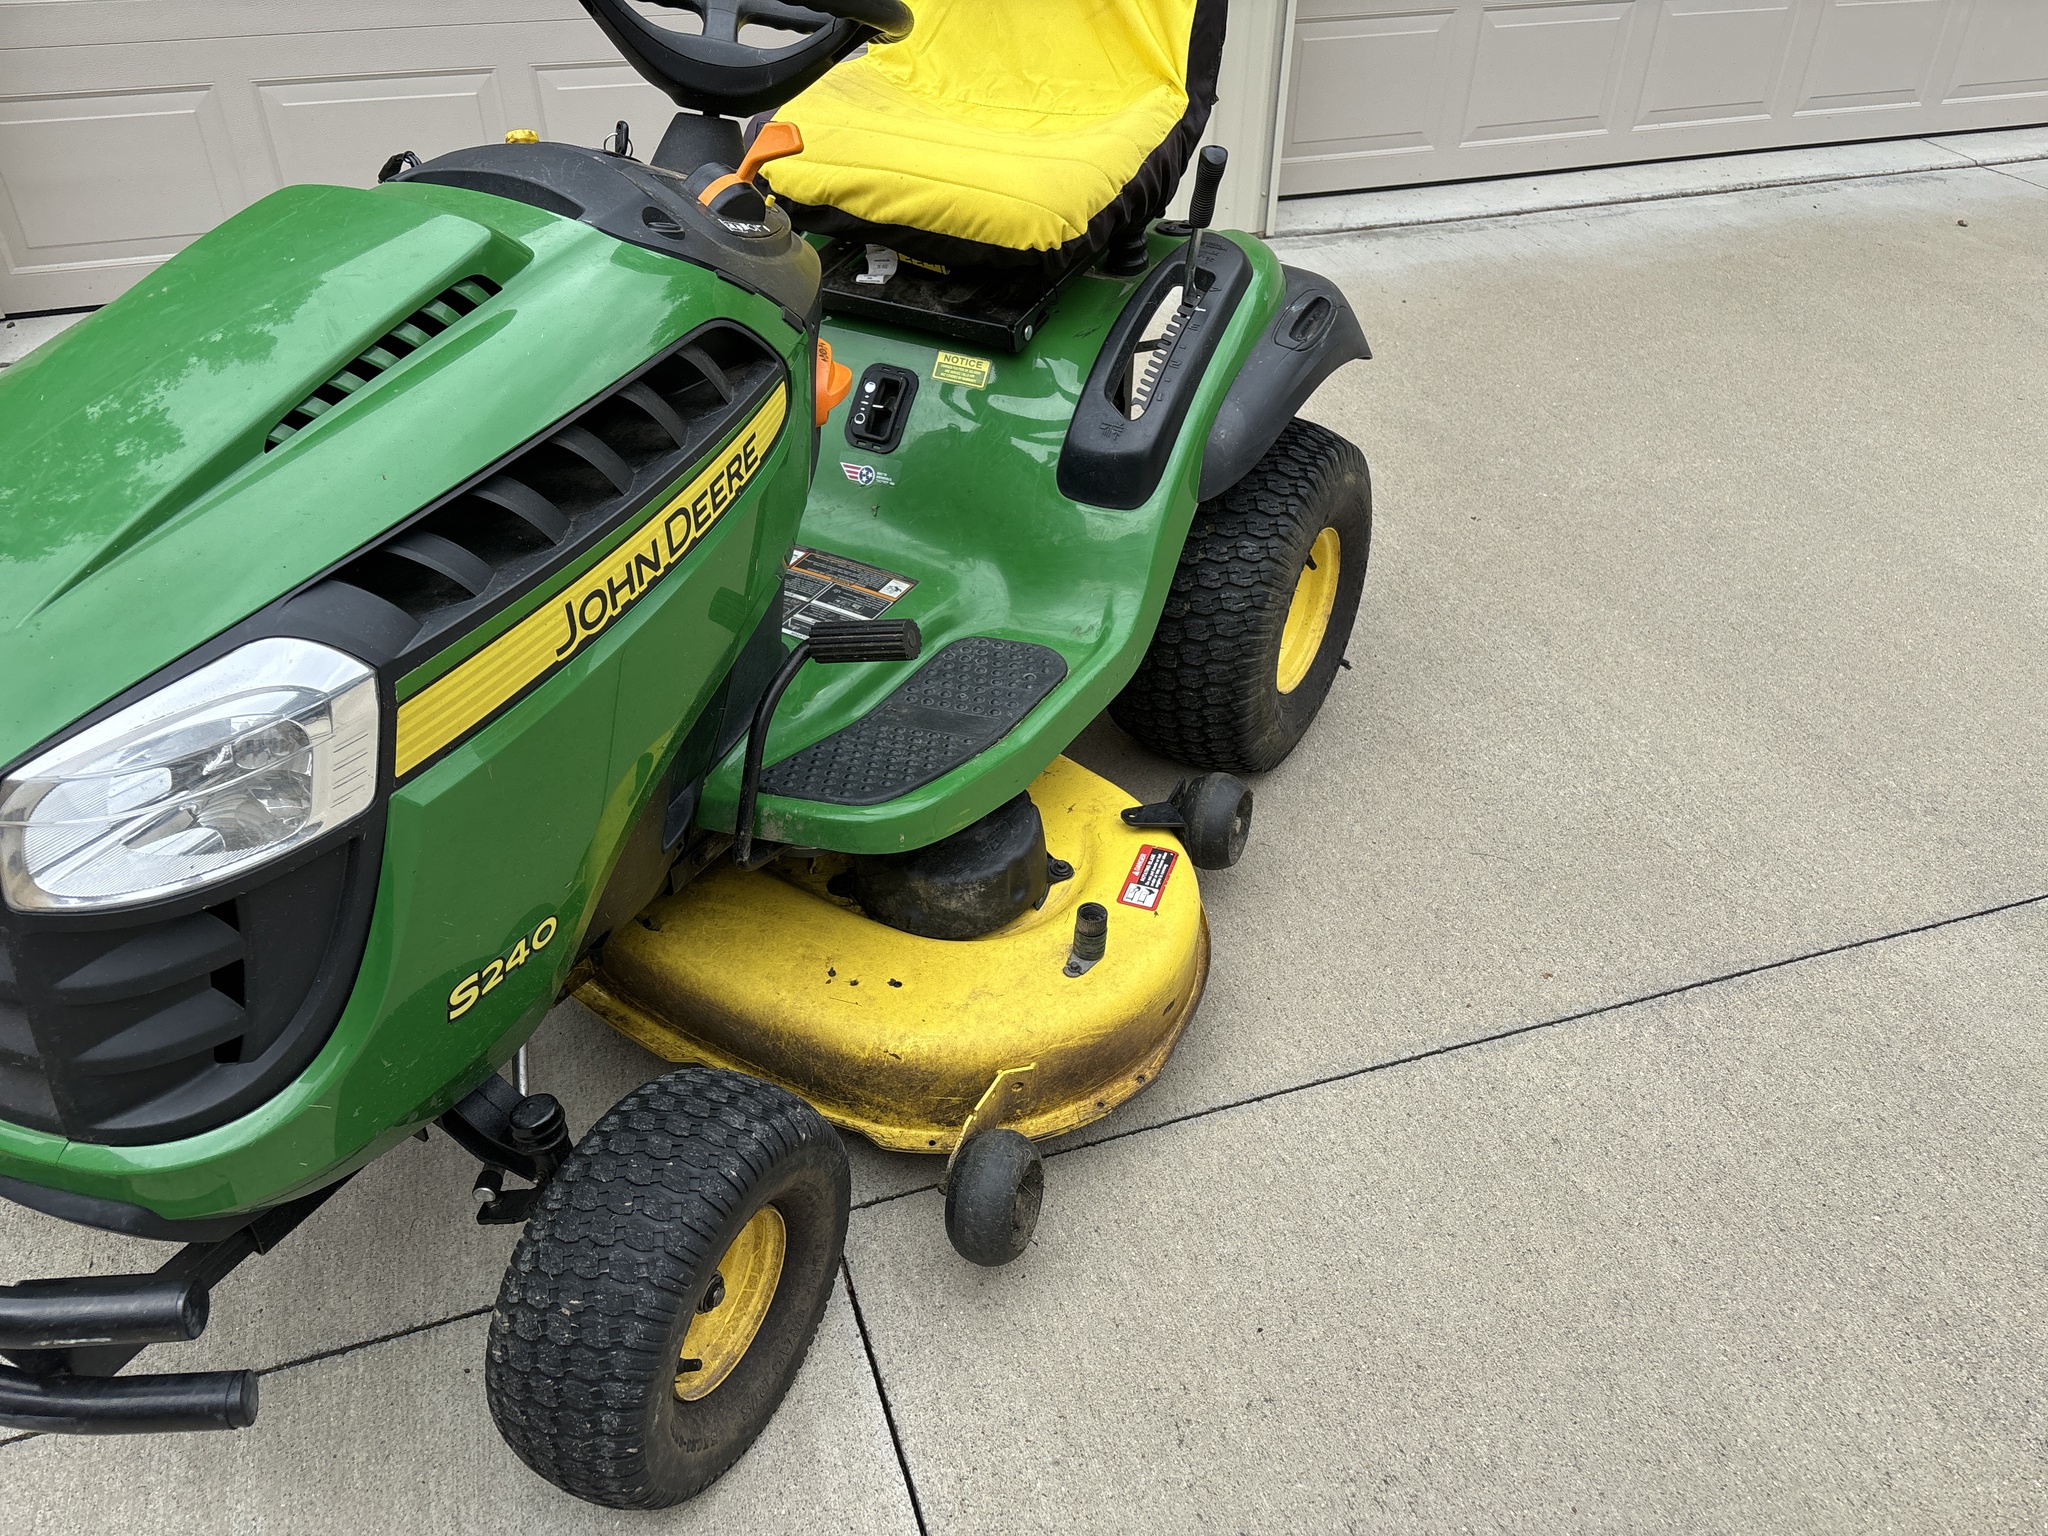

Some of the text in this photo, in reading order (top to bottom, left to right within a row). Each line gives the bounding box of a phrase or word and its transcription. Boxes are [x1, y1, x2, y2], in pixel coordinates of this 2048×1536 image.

[943, 354, 983, 369] NOTICE
[555, 432, 760, 659] JOHN DEERE
[1134, 853, 1147, 872] DANGER
[449, 916, 557, 1021] S240
